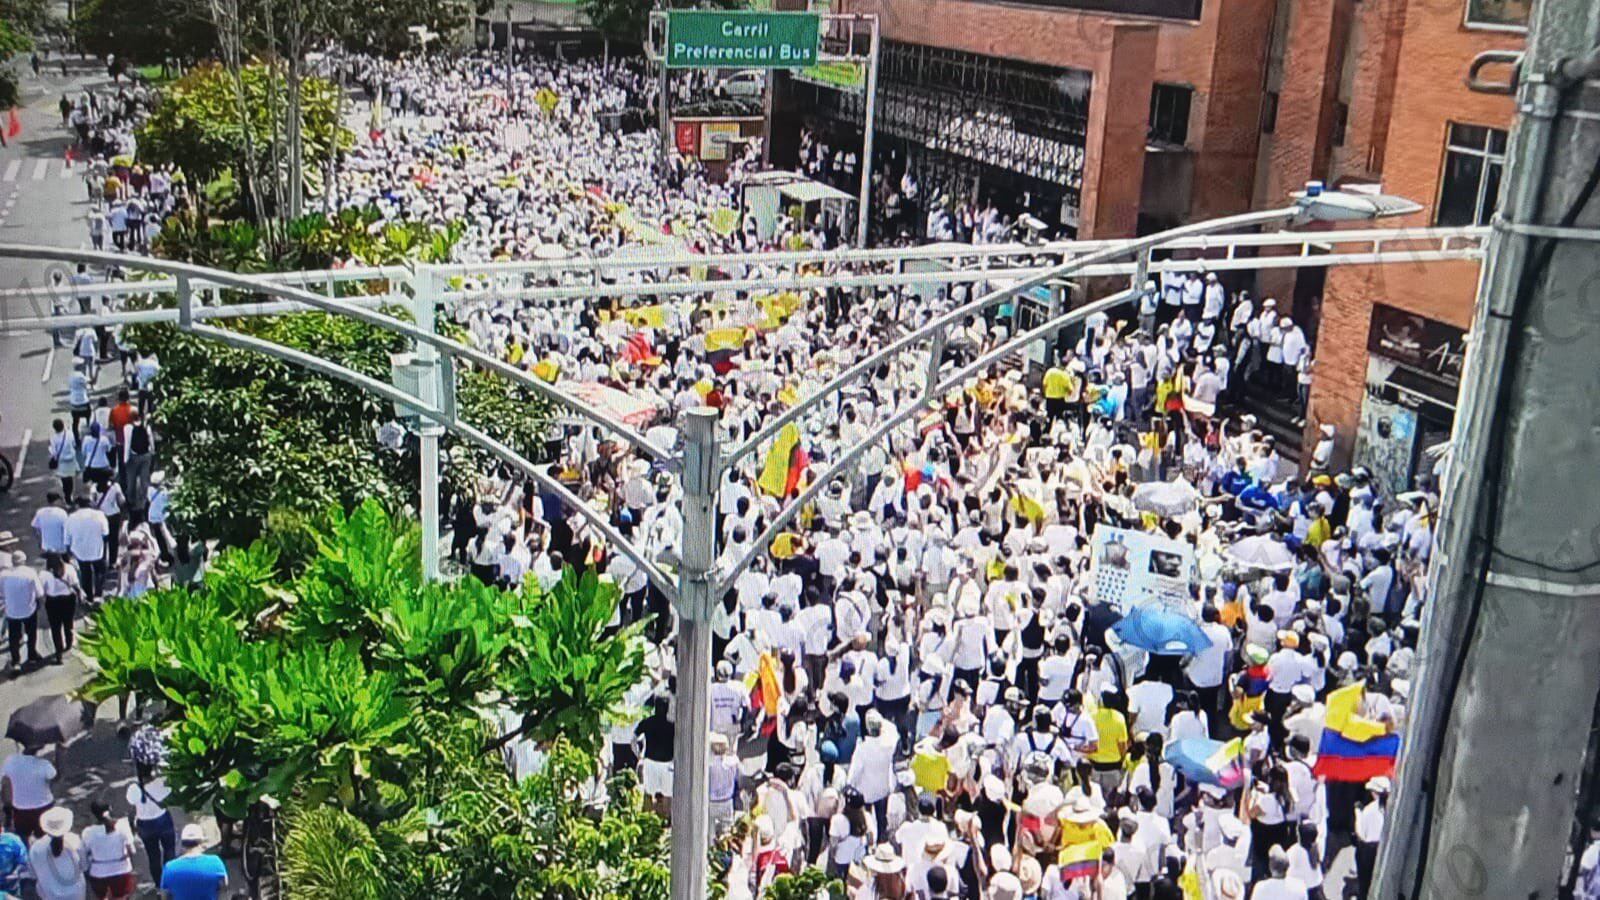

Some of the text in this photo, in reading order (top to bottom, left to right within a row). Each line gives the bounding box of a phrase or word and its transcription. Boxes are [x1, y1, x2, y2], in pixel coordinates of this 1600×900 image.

[722, 21, 768, 37] Carril
[674, 43, 810, 59] Preferencial Bus
